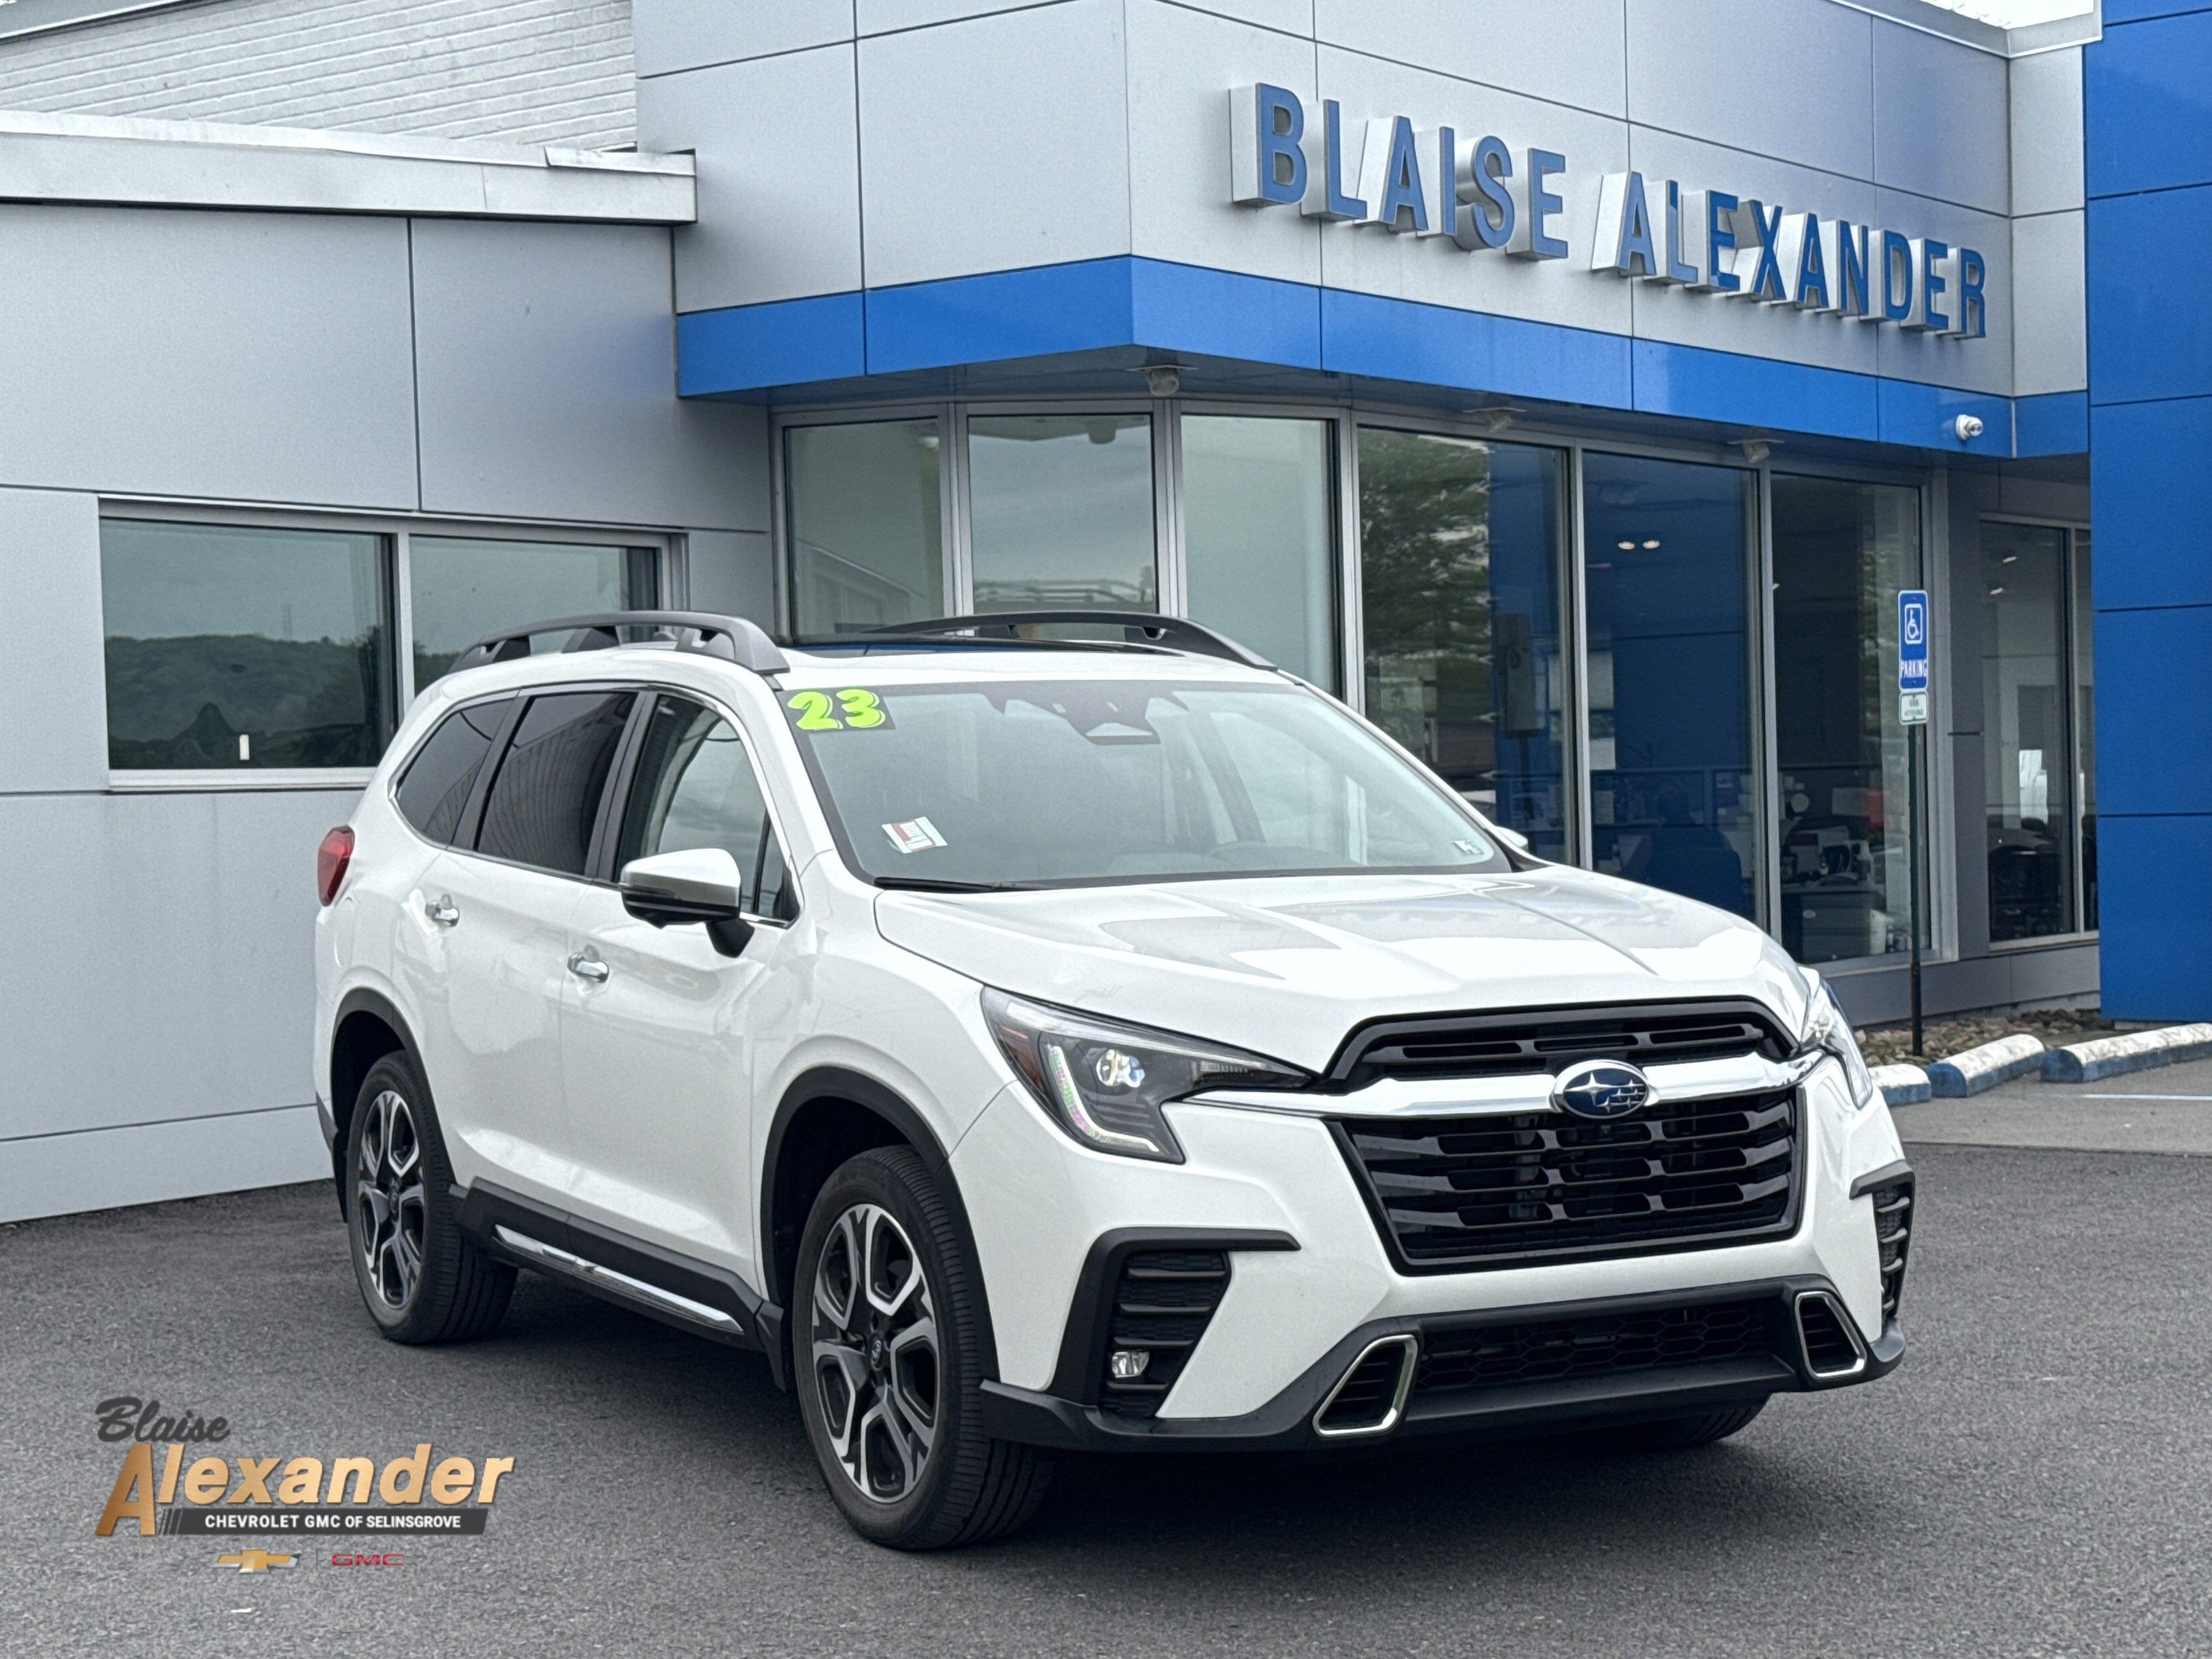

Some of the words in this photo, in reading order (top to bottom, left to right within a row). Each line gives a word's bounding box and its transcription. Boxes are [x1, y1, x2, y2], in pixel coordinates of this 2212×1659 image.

[1254, 81, 1569, 260] BLAISE
[1616, 171, 1987, 339] ALEXANDER
[1901, 659, 1927, 679] PARKING
[787, 687, 886, 731] 23
